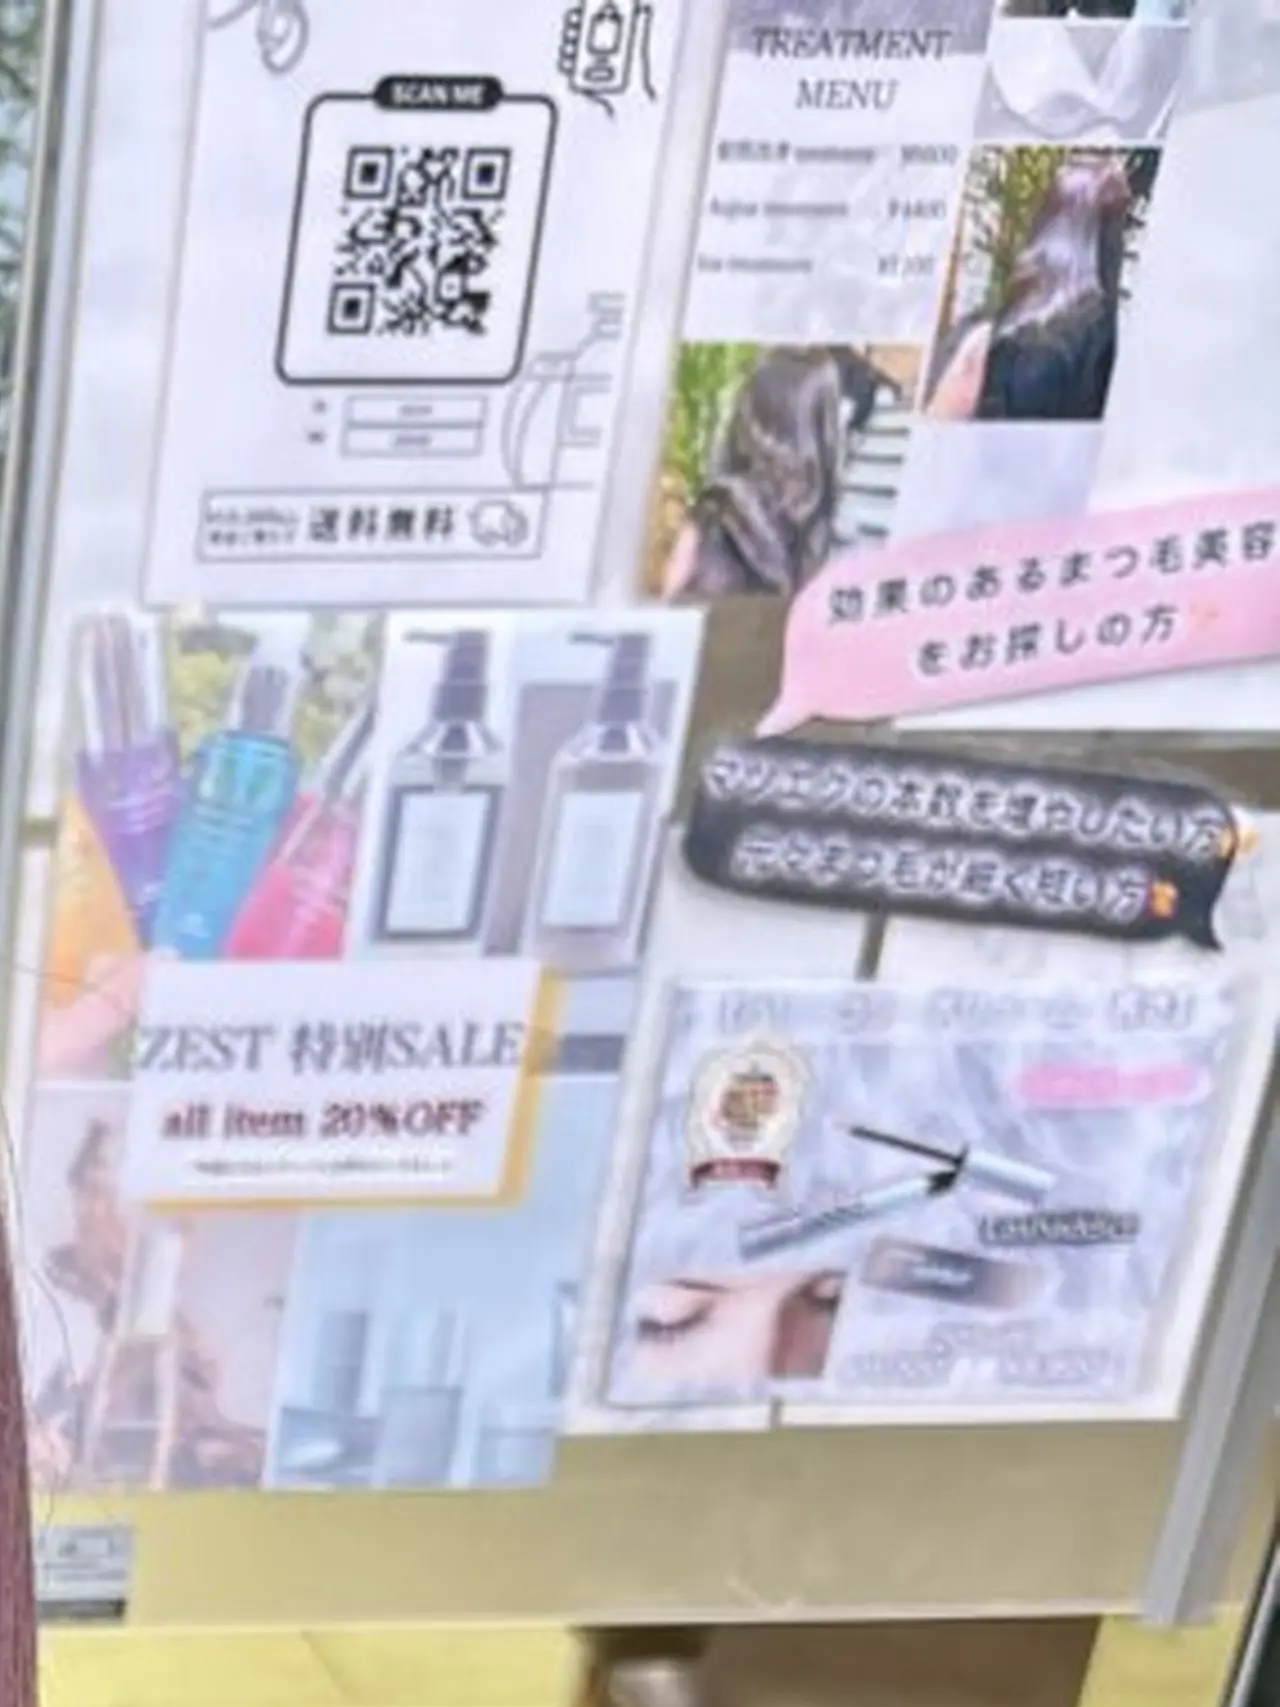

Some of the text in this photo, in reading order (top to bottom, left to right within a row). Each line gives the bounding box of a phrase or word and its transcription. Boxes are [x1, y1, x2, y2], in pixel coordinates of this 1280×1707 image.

[751, 26, 953, 60] TREATMENT
[390, 81, 486, 105] SCAN ME
[795, 76, 900, 110] MENU
[308, 503, 456, 544] 送料無料
[826, 519, 1277, 627] 効果のあるまつ毛美容
[915, 603, 1179, 677] をお探しの方
[136, 1022, 275, 1072] ZEST
[162, 1097, 484, 1139] all item 20%OFF
